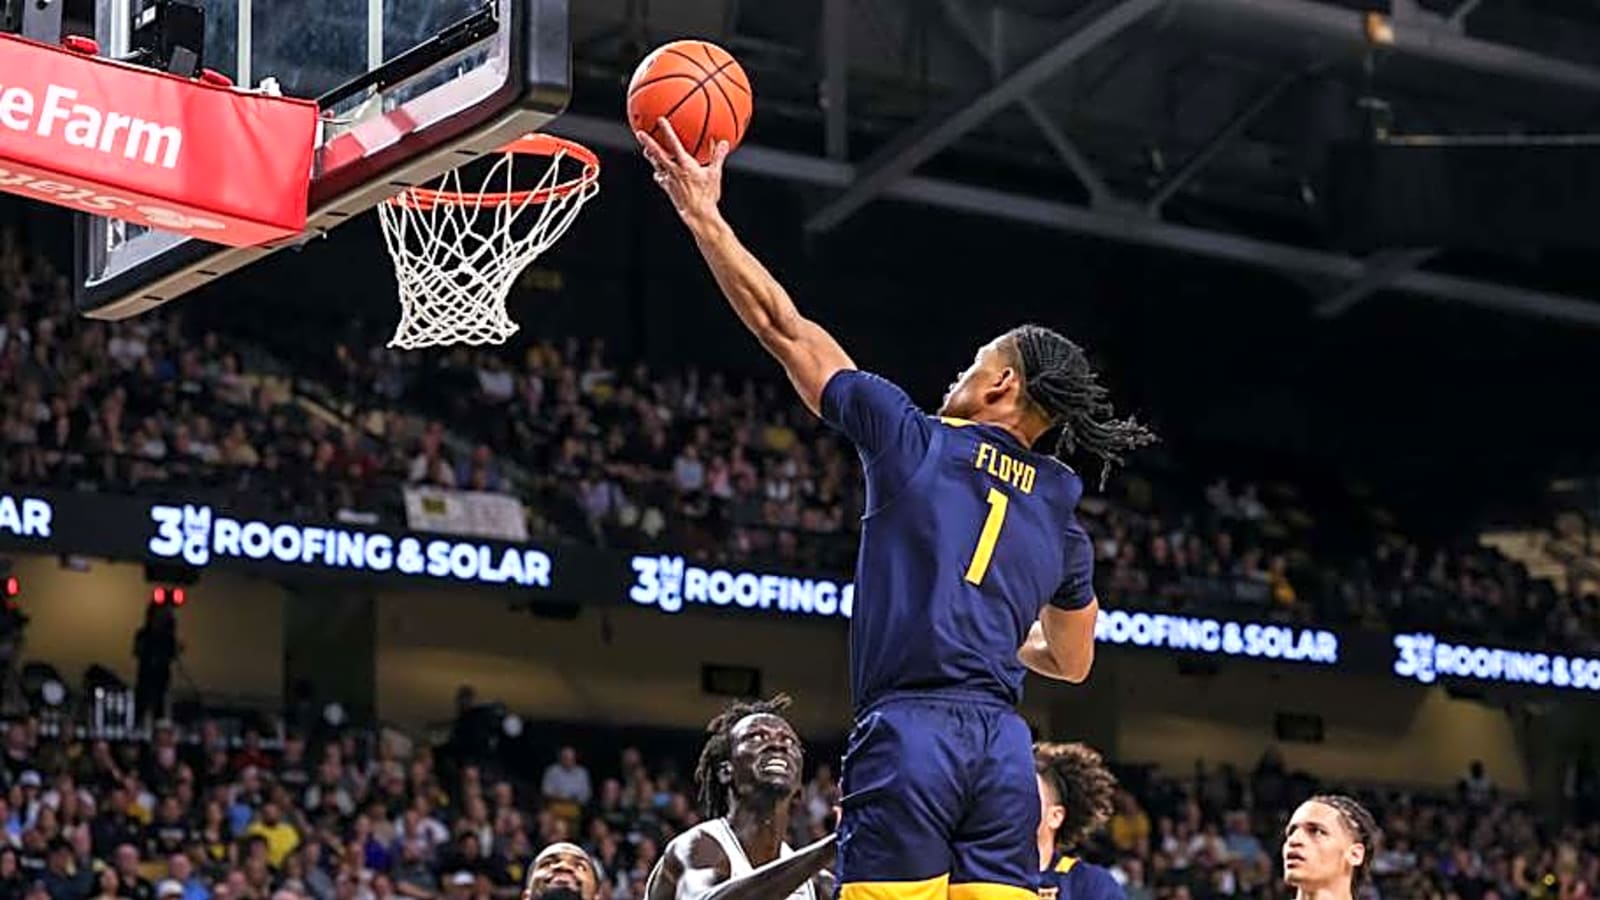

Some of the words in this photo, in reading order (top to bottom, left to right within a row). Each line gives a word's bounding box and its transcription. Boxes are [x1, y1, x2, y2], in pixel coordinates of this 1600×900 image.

[975, 443, 1036, 494] FLOYD
[0, 496, 52, 537] AR
[965, 487, 1009, 586] 1
[213, 518, 393, 570] ROOFING
[397, 537, 425, 574] &
[426, 540, 551, 587] SOLAR
[684, 566, 838, 616] ROOFING
[1222, 621, 1243, 654] &
[1243, 623, 1337, 663] SOLAR
[1435, 643, 1549, 684] ROOFING
